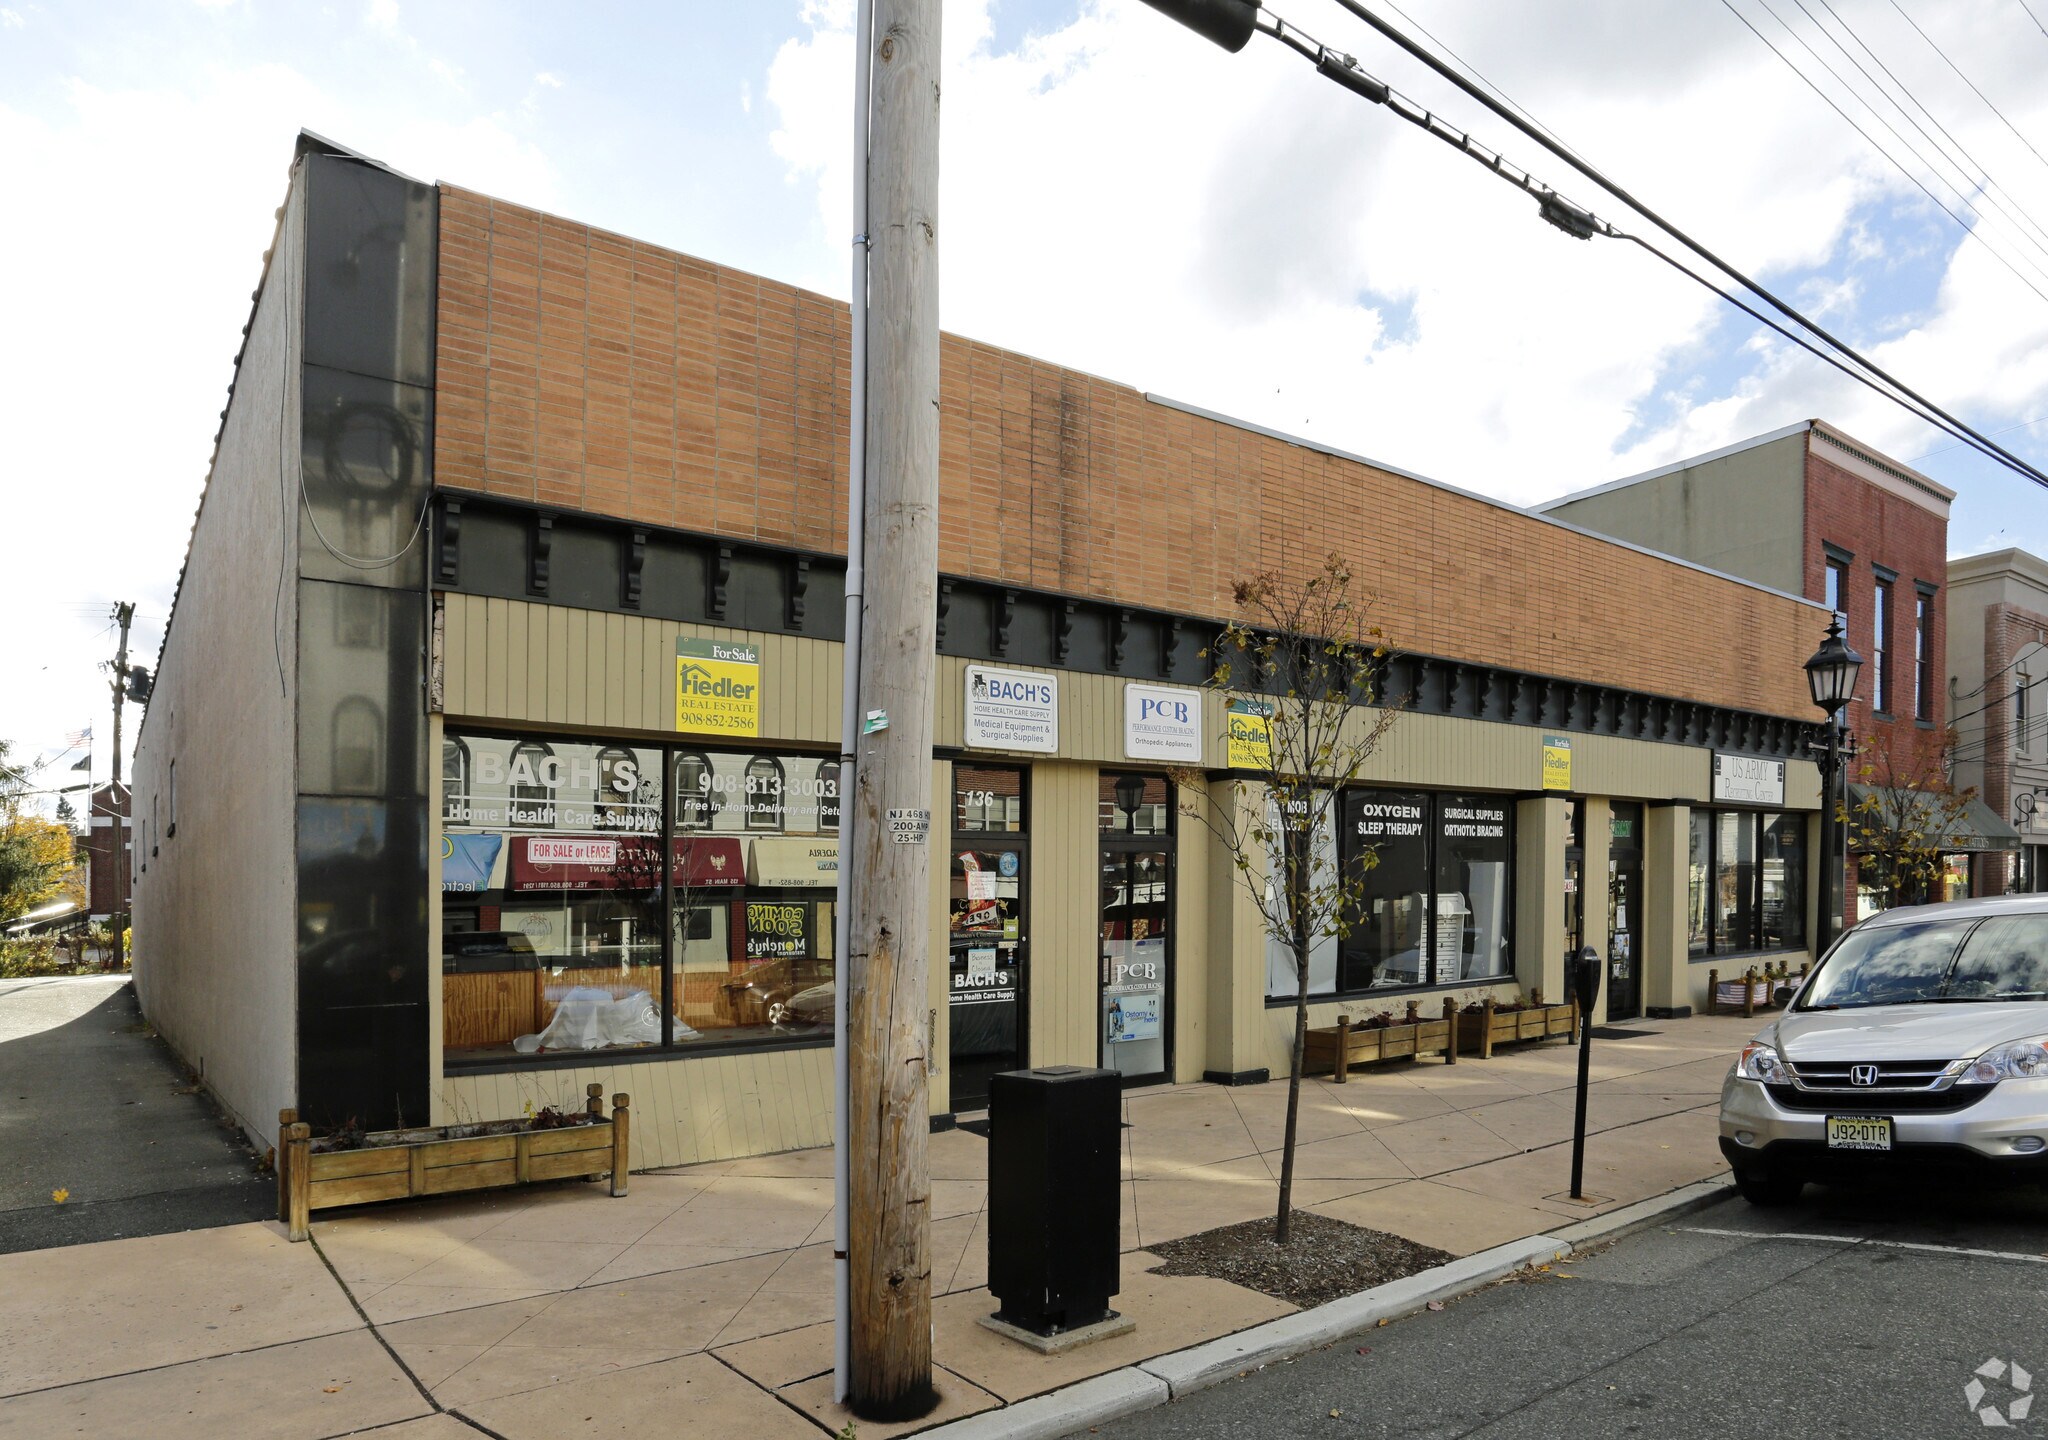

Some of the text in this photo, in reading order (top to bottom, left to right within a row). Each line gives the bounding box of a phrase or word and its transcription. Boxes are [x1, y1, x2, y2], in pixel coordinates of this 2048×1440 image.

[680, 664, 755, 699] Fiedler
[990, 680, 1051, 704] BACH'S
[681, 699, 755, 713] REAL ESTATE
[975, 705, 1050, 719] HOME HEALTH CARE SUPPLY
[1140, 698, 1188, 723] PCB
[974, 718, 1051, 734] Medical Equipment &
[981, 729, 1044, 743] Surgical Supplies
[1135, 738, 1193, 748] Orthopedic Appliances
[476, 751, 639, 793] BACH'S
[1732, 757, 1768, 781] US ARMY
[699, 773, 837, 798] 908-813-3003
[966, 790, 994, 807] 136
[684, 800, 841, 816] Free In-Home Delivery and Setu
[906, 810, 923, 819] 468
[1363, 804, 1421, 819] OXYGEN
[1444, 808, 1504, 821] SURGICAL SUPPLIES
[450, 803, 657, 831] Home Health Care Supply
[1358, 822, 1422, 836] SLEEP THERAPY
[1444, 824, 1504, 837] ORTHOTIC BRACING
[534, 843, 611, 859] FOR SALE or LEASE
[955, 971, 1008, 988] BACH'S
[1115, 962, 1157, 983] PCB
[949, 991, 1015, 1002] ome Health Care Supply
